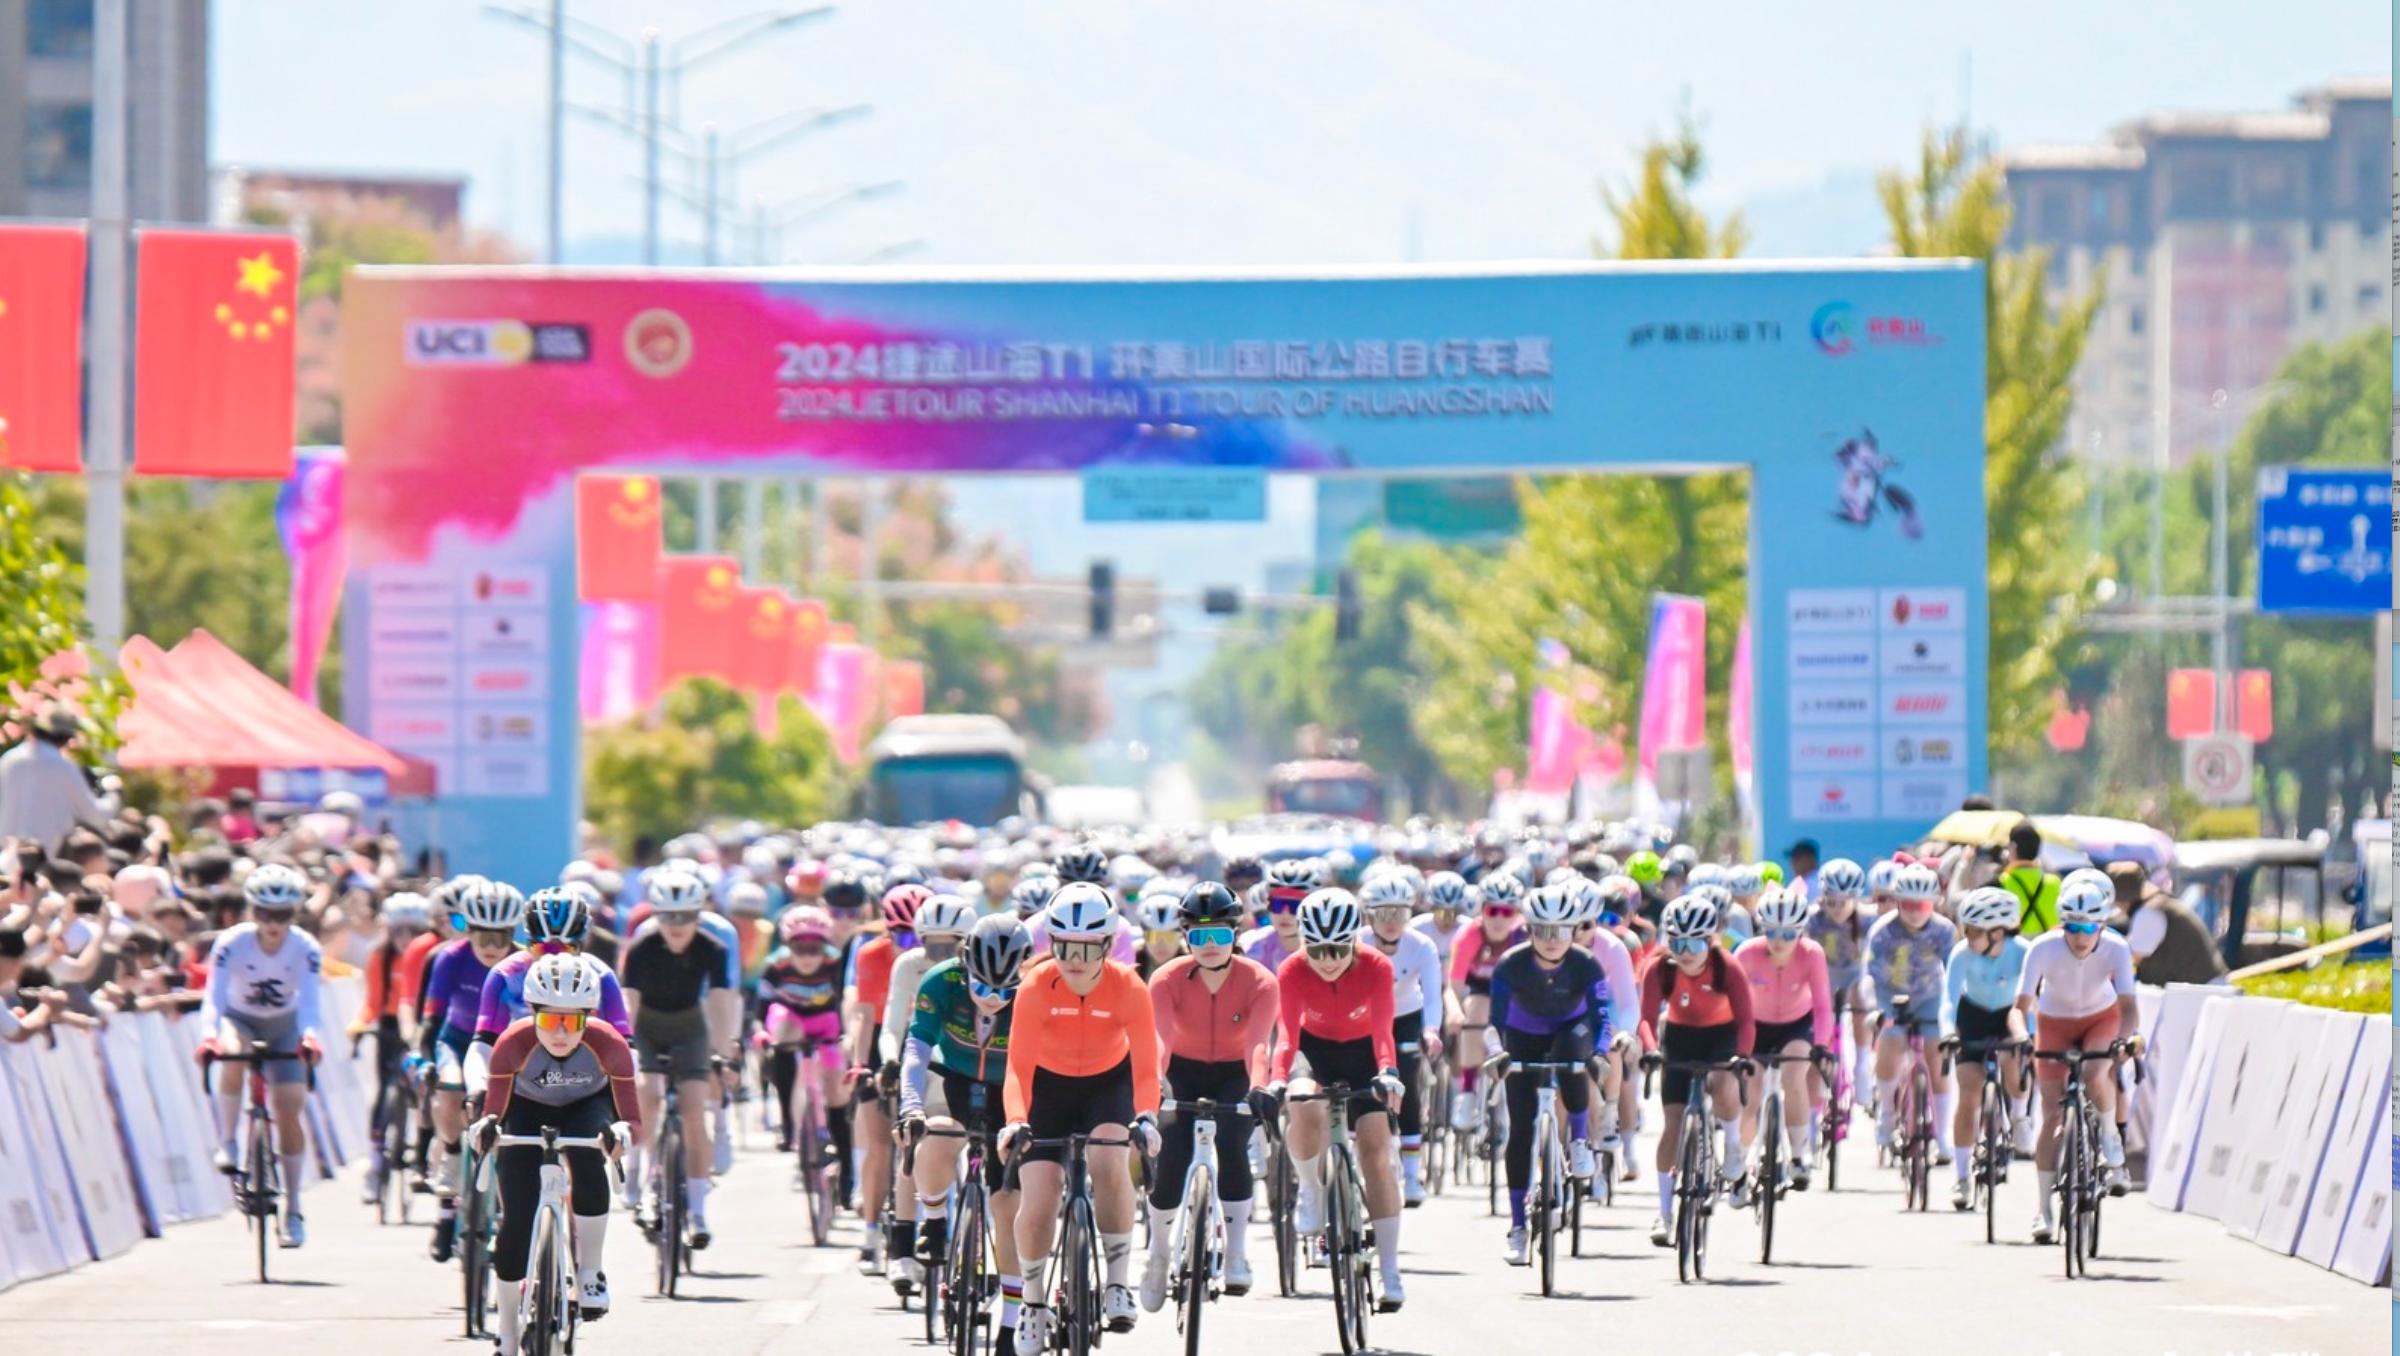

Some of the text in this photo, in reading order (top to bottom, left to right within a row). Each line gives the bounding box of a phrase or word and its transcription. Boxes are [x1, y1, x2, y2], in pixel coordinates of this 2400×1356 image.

[416, 326, 485, 354] UCI
[993, 386, 1139, 419] SHANHAI
[1193, 385, 1286, 417] TOUR
[1293, 385, 1335, 417] OF
[1343, 383, 1554, 417] HUANGSHAN
